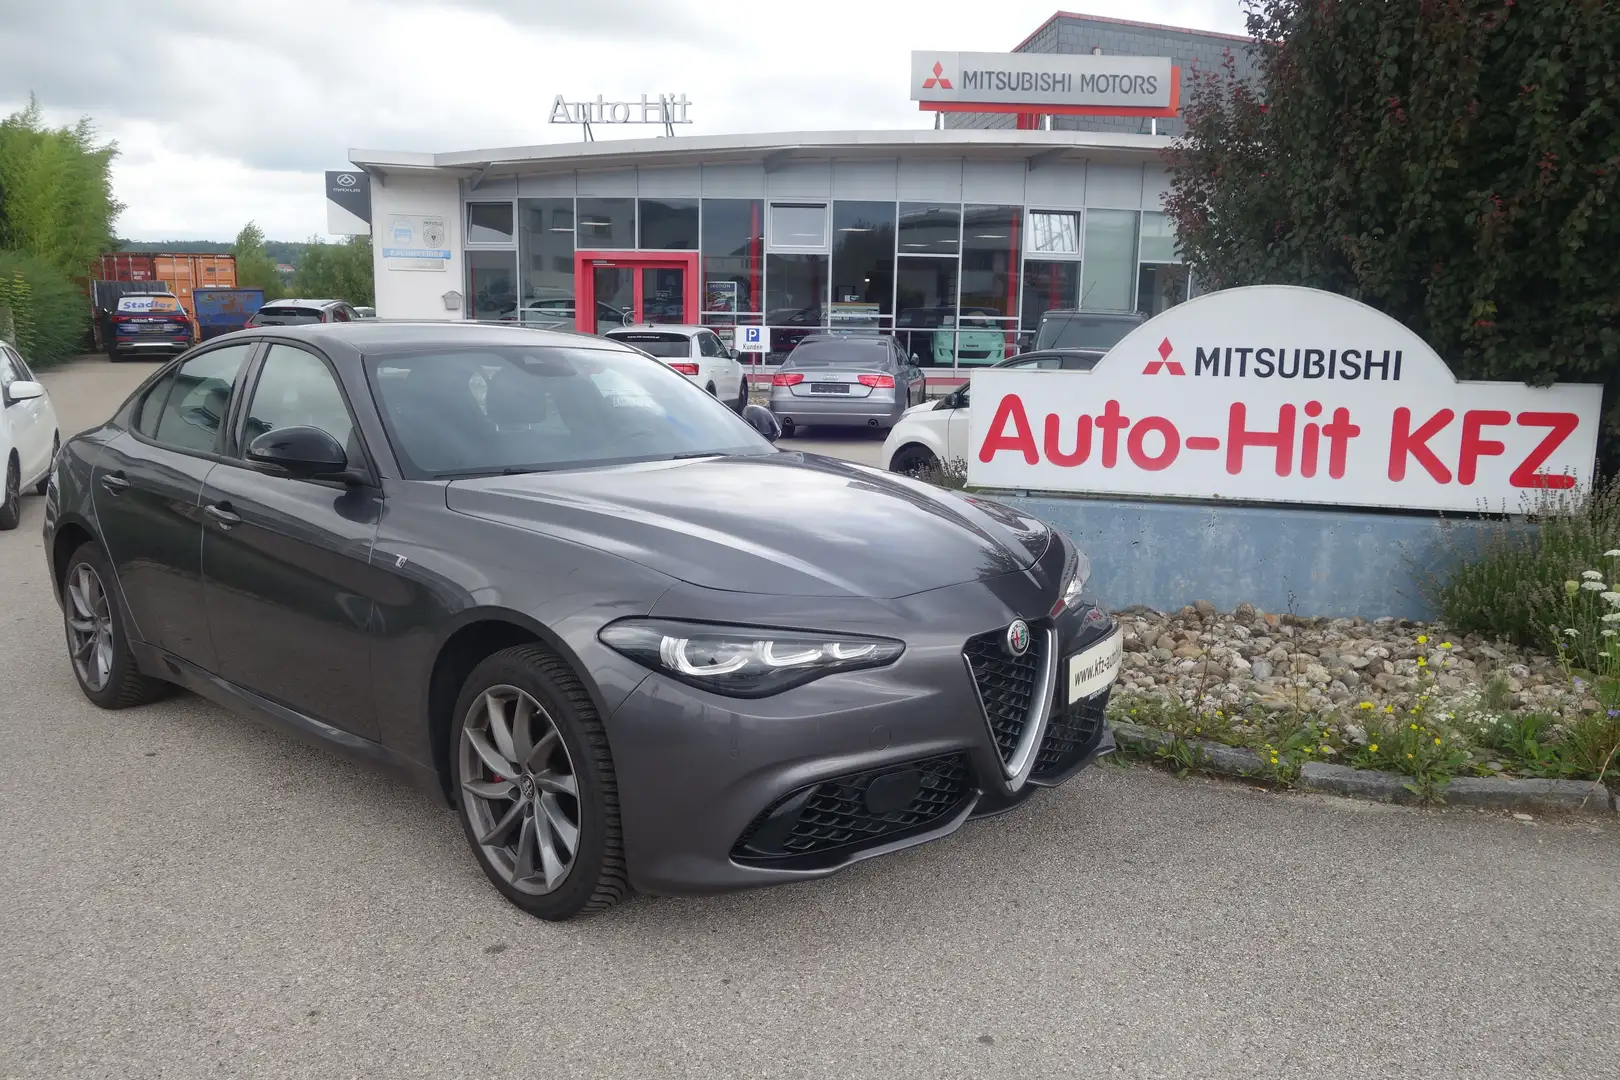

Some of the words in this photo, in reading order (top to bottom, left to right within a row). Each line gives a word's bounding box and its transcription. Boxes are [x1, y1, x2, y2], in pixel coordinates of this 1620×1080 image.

[963, 70, 1071, 93] MITSUBISHI
[1080, 74, 1158, 95] MOTORS
[548, 94, 630, 123] Auto
[641, 93, 693, 123] Hit
[123, 300, 172, 309] Stadler
[742, 343, 763, 351] Kunden
[1194, 347, 1403, 381] MITSUBISHI
[978, 393, 1361, 480] Auto-Hit
[1387, 406, 1580, 490] KFZ
